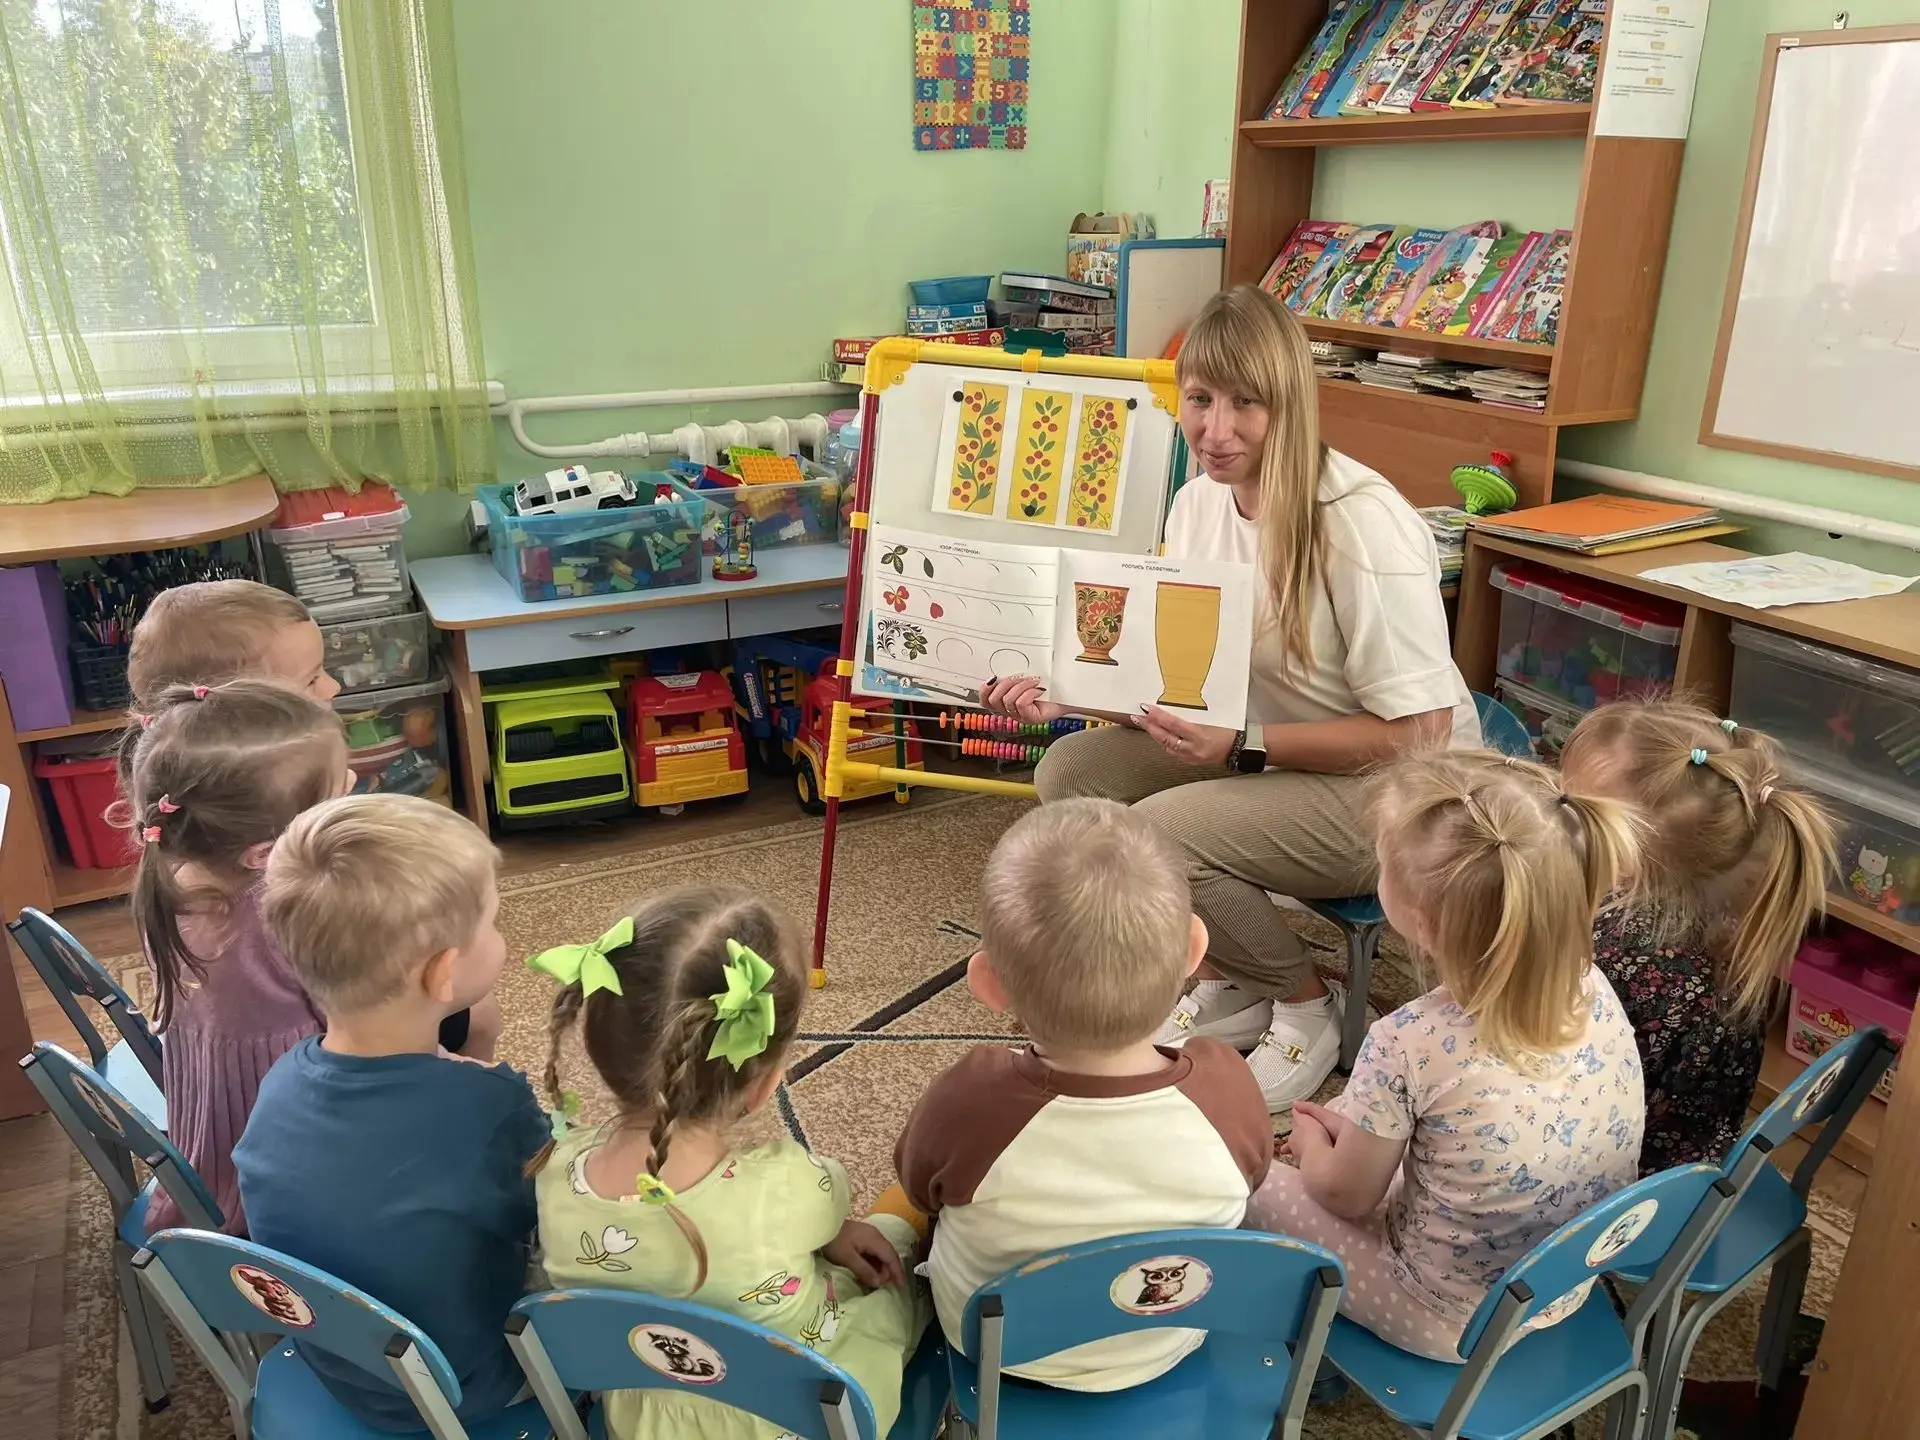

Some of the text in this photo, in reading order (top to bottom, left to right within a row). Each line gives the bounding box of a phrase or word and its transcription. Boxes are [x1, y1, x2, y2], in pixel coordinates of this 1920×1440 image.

[921, 13, 931, 25] 4
[940, 13, 950, 28] 2
[959, 14, 966, 29] 1
[977, 13, 987, 28] 9
[995, 15, 1005, 29] 7
[941, 37, 951, 51] 4
[978, 38, 987, 52] 2
[923, 60, 932, 73] 6
[923, 83, 933, 97] 5
[995, 85, 1004, 99] 5
[1013, 86, 1023, 100] 2
[921, 131, 931, 145] 6
[1011, 130, 1021, 144] 3
[1145, 565, 1181, 573] САЛФЕТНИЦЫ
[1801, 1004, 1815, 1016] LEGO
[1818, 1012, 1855, 1037] dupl
